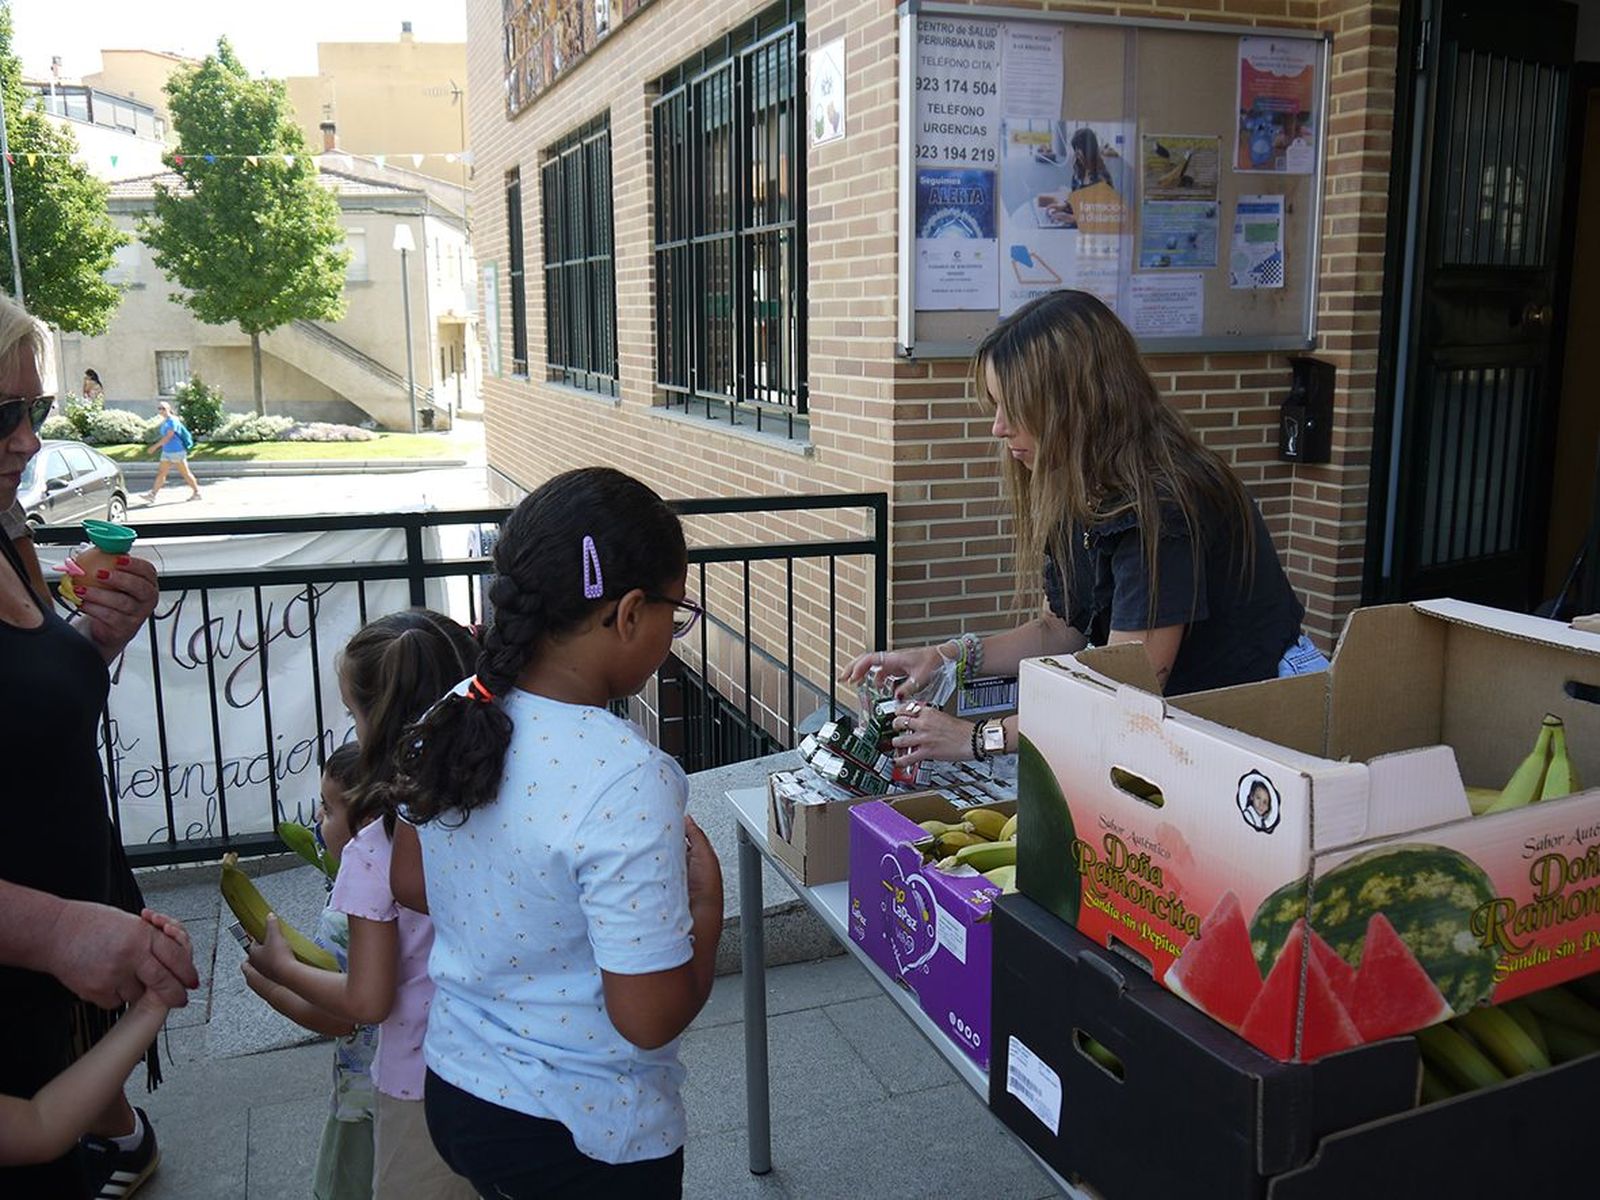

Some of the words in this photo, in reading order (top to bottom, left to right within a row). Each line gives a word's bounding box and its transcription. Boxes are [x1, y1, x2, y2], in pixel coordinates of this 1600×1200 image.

[916, 20, 953, 34] CENTRO
[956, 25, 967, 36] de
[969, 26, 998, 38] SALUD
[917, 34, 976, 49] PERIURBANA
[977, 39, 996, 51] SUR
[971, 60, 992, 71] CITA
[915, 76, 939, 92] 923
[945, 79, 968, 94] 174
[973, 81, 998, 96] 504
[923, 122, 988, 136] URGENCIAS
[943, 146, 967, 160] 194
[971, 147, 996, 162] 219
[928, 186, 985, 205] ALERTA
[1521, 832, 1565, 860] Sabor
[1103, 832, 1164, 889] Doña
[1071, 838, 1202, 941] Ramoncita
[1122, 912, 1138, 932] sin
[1138, 921, 1183, 958] Pepitas
[1555, 939, 1576, 959] sin
